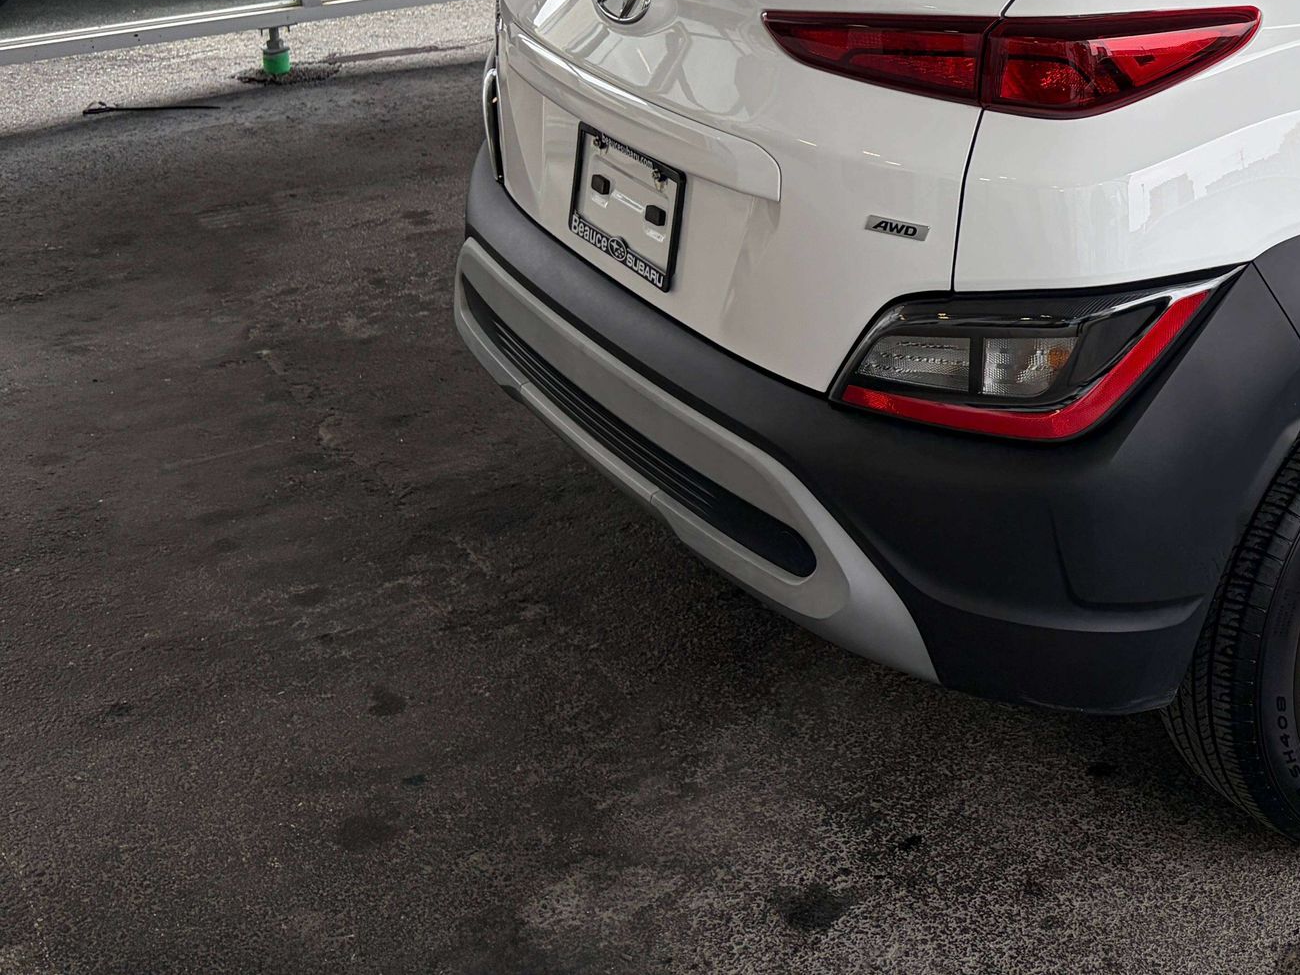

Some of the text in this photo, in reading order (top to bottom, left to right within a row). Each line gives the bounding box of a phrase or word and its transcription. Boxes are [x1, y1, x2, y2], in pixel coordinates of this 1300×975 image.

[571, 214, 664, 288] Beauce SUBARU
[872, 220, 918, 237] AWD
